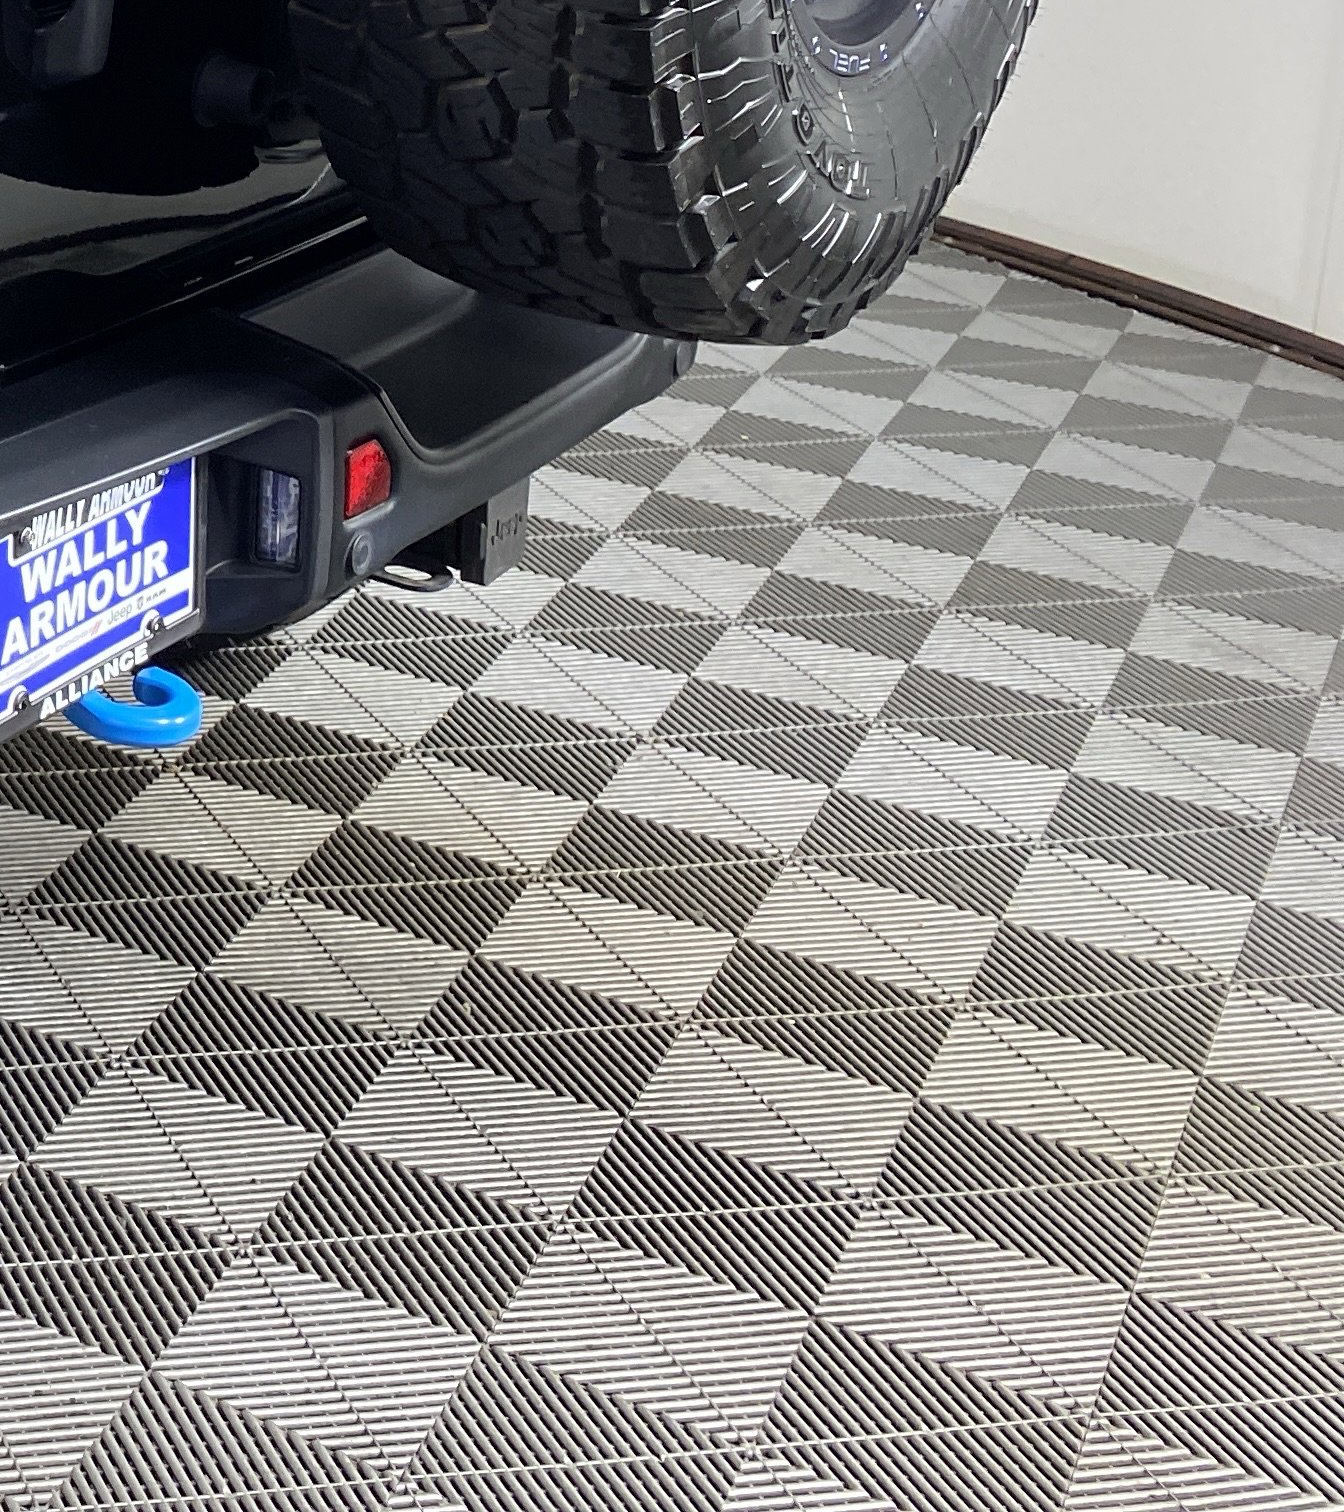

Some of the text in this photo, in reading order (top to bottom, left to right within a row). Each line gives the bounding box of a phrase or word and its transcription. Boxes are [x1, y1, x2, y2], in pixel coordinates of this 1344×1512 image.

[829, 47, 871, 74] FUEL
[20, 500, 152, 603] WALLY
[31, 498, 87, 551] WALLY
[0, 539, 170, 666] ARMOUR
[108, 603, 133, 626] Jeep
[39, 641, 150, 720] ALLIANCE
